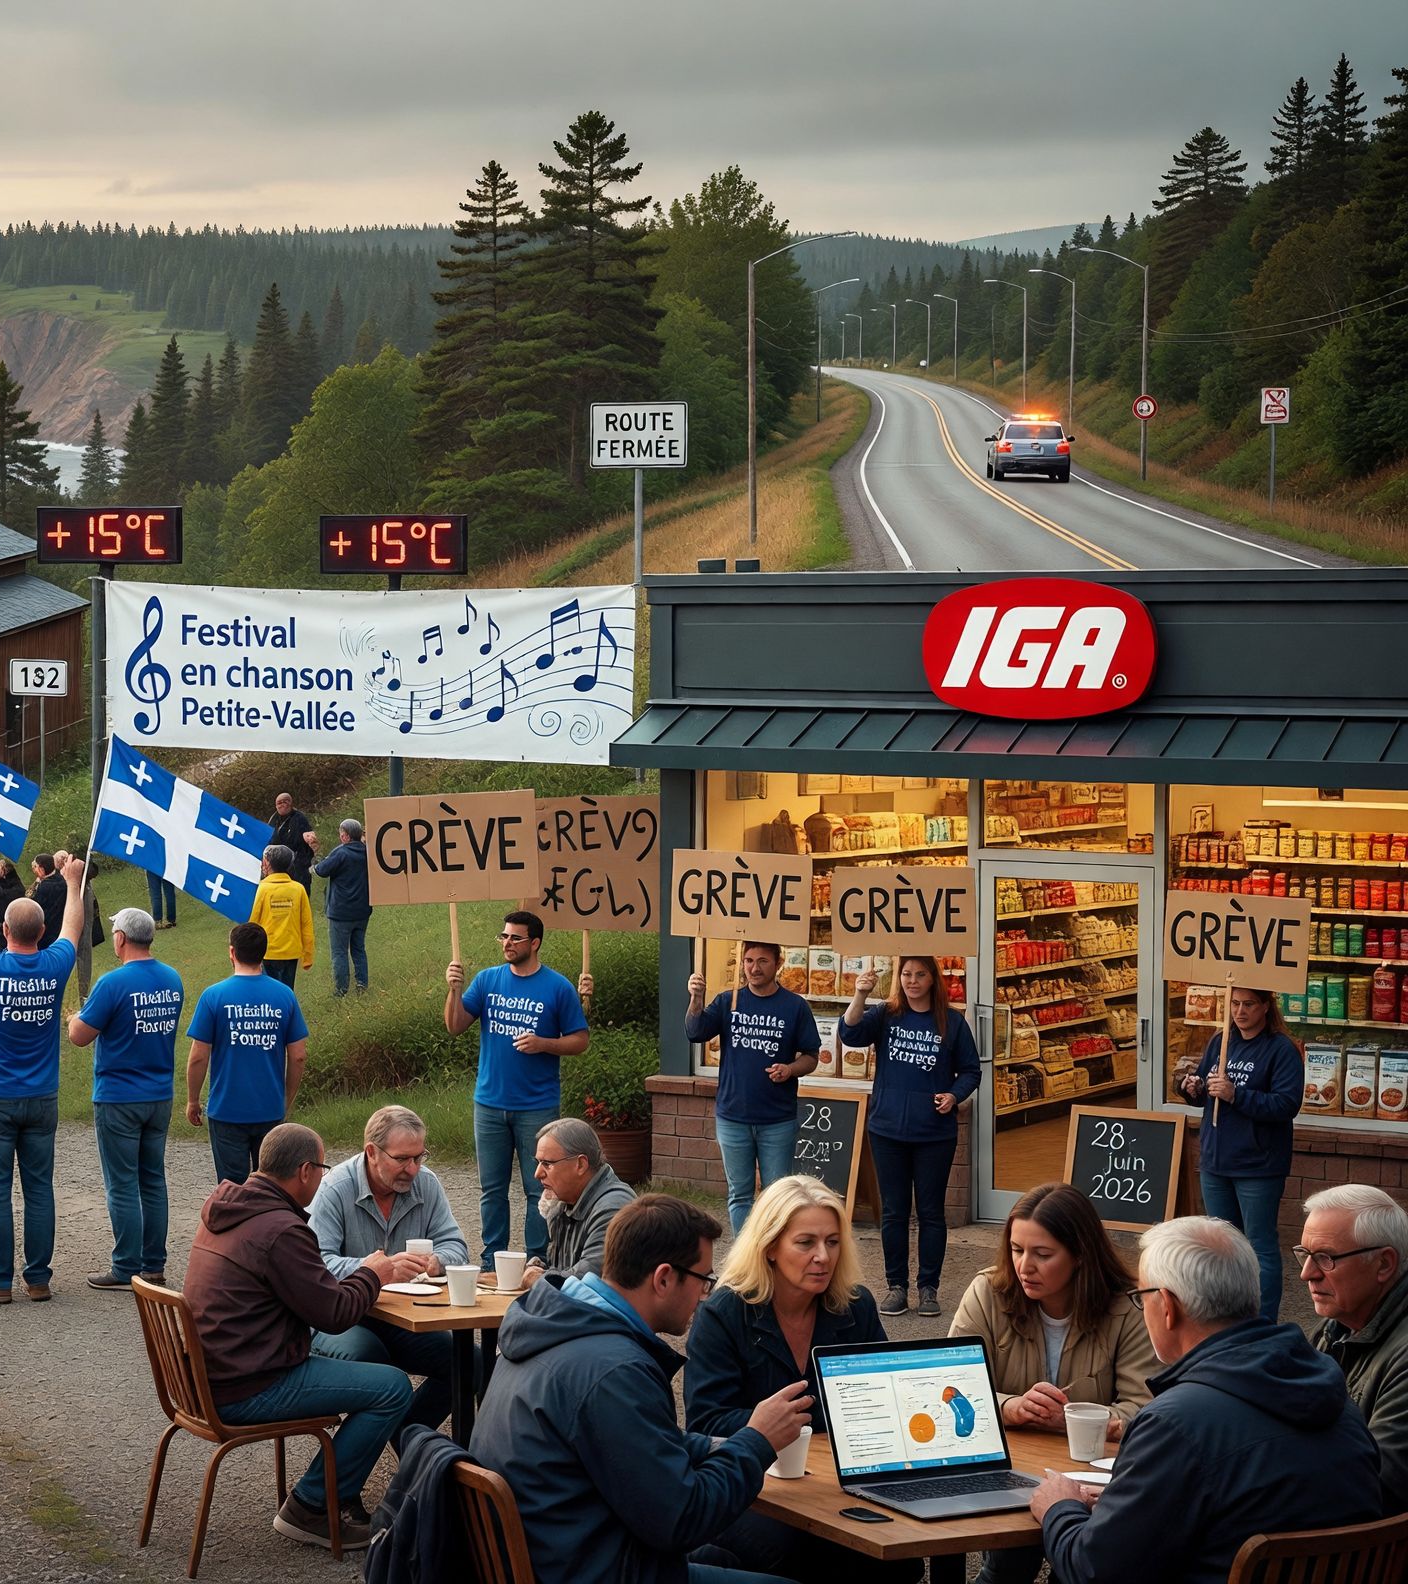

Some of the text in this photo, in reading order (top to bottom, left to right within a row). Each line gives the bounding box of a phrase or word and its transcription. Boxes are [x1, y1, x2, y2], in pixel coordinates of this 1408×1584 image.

[605, 412, 674, 432] ROUTE
[597, 435, 680, 458] FERMÉE
[181, 614, 296, 649] Festival
[181, 656, 353, 691] en chanson
[181, 697, 356, 732] Petite-Vallée
[375, 802, 525, 877] GRÈVE
[678, 856, 802, 922] GRÈVE
[838, 873, 967, 934] GRÈVE
[1170, 898, 1301, 968] GRÈVE
[800, 1103, 832, 1132] 28
[1091, 1121, 1125, 1150] 28
[1103, 1151, 1145, 1177] juin
[1088, 1174, 1152, 1203] 2026
